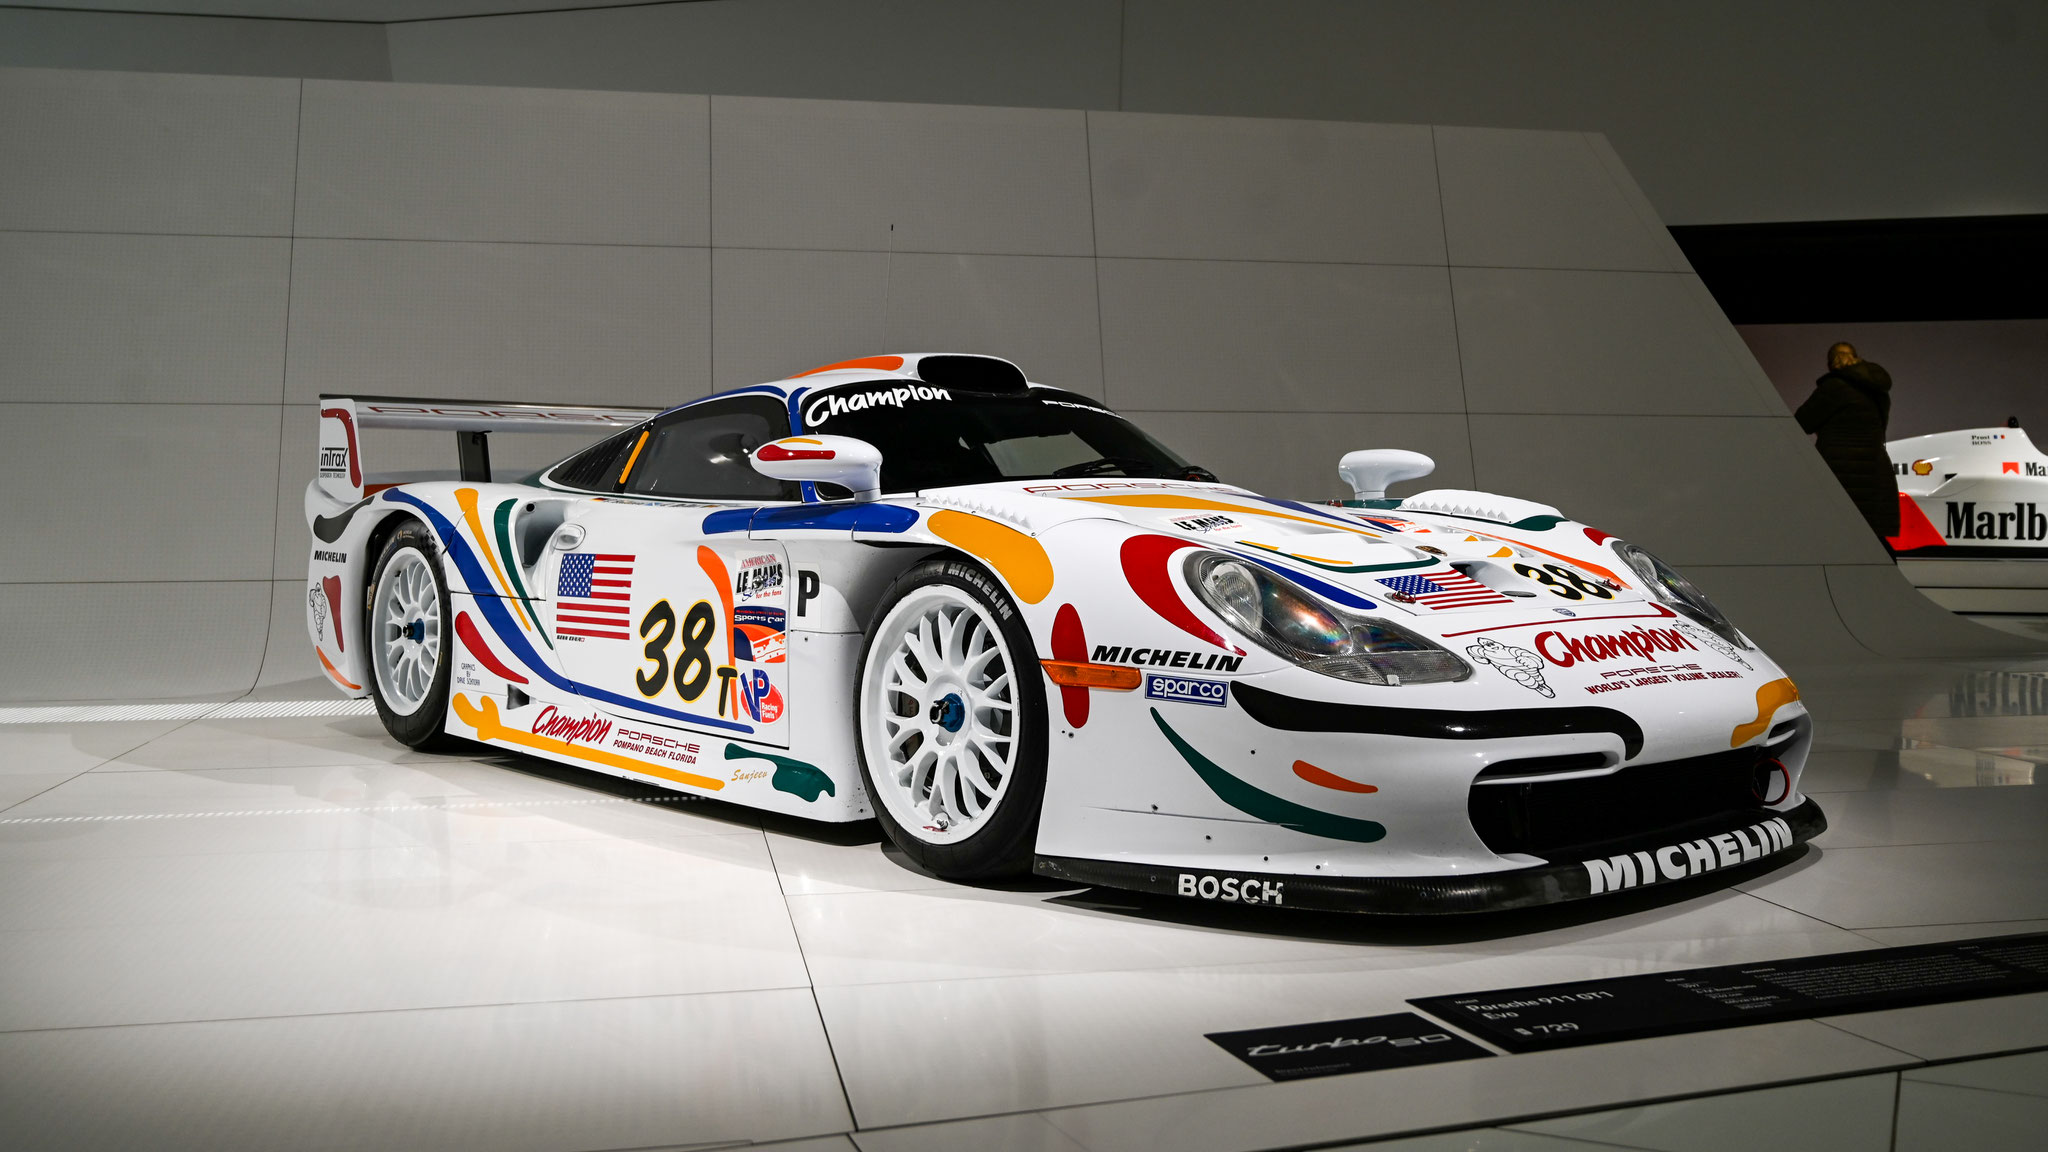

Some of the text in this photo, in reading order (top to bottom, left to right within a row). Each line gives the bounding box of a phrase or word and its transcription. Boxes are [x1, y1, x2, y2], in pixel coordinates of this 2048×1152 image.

[367, 406, 648, 420] PORSC
[805, 384, 952, 428] Champion
[2025, 461, 2048, 477] Ma
[1945, 501, 2048, 541] Marlb
[314, 550, 347, 564] MICHELIN
[741, 553, 777, 569] AMERICAN
[736, 563, 783, 594] LE MANS
[1512, 562, 1615, 601] 38
[763, 590, 771, 598] the
[797, 568, 820, 618] P
[947, 562, 1013, 621] MICHELIN
[734, 614, 785, 624] Sports Car
[1091, 644, 1243, 672] MICHELIN
[1534, 623, 1700, 668] Champion
[1584, 680, 1630, 695] WORLD'S
[1629, 674, 1672, 687] LARGEST
[1671, 672, 1708, 682] VOLUME
[1600, 662, 1702, 680] PORSCHE
[740, 668, 771, 722] VP
[1152, 677, 1224, 702] sparco
[761, 702, 778, 712] Racing
[762, 710, 776, 720] Fuels
[531, 705, 613, 746] Champion
[613, 739, 697, 765] POMPANO BEACH FLORIDA
[617, 728, 701, 754] PORSCHE
[1581, 816, 1794, 895] MICHELIN
[1178, 873, 1284, 905] BOSCH
[1464, 999, 1541, 1012] Porsche
[1537, 994, 1577, 1005] 911
[1576, 990, 1615, 1001] GT1
[1482, 1011, 1520, 1020] Evo
[1532, 1022, 1580, 1034] 729
[1246, 1036, 1388, 1056] turbo
